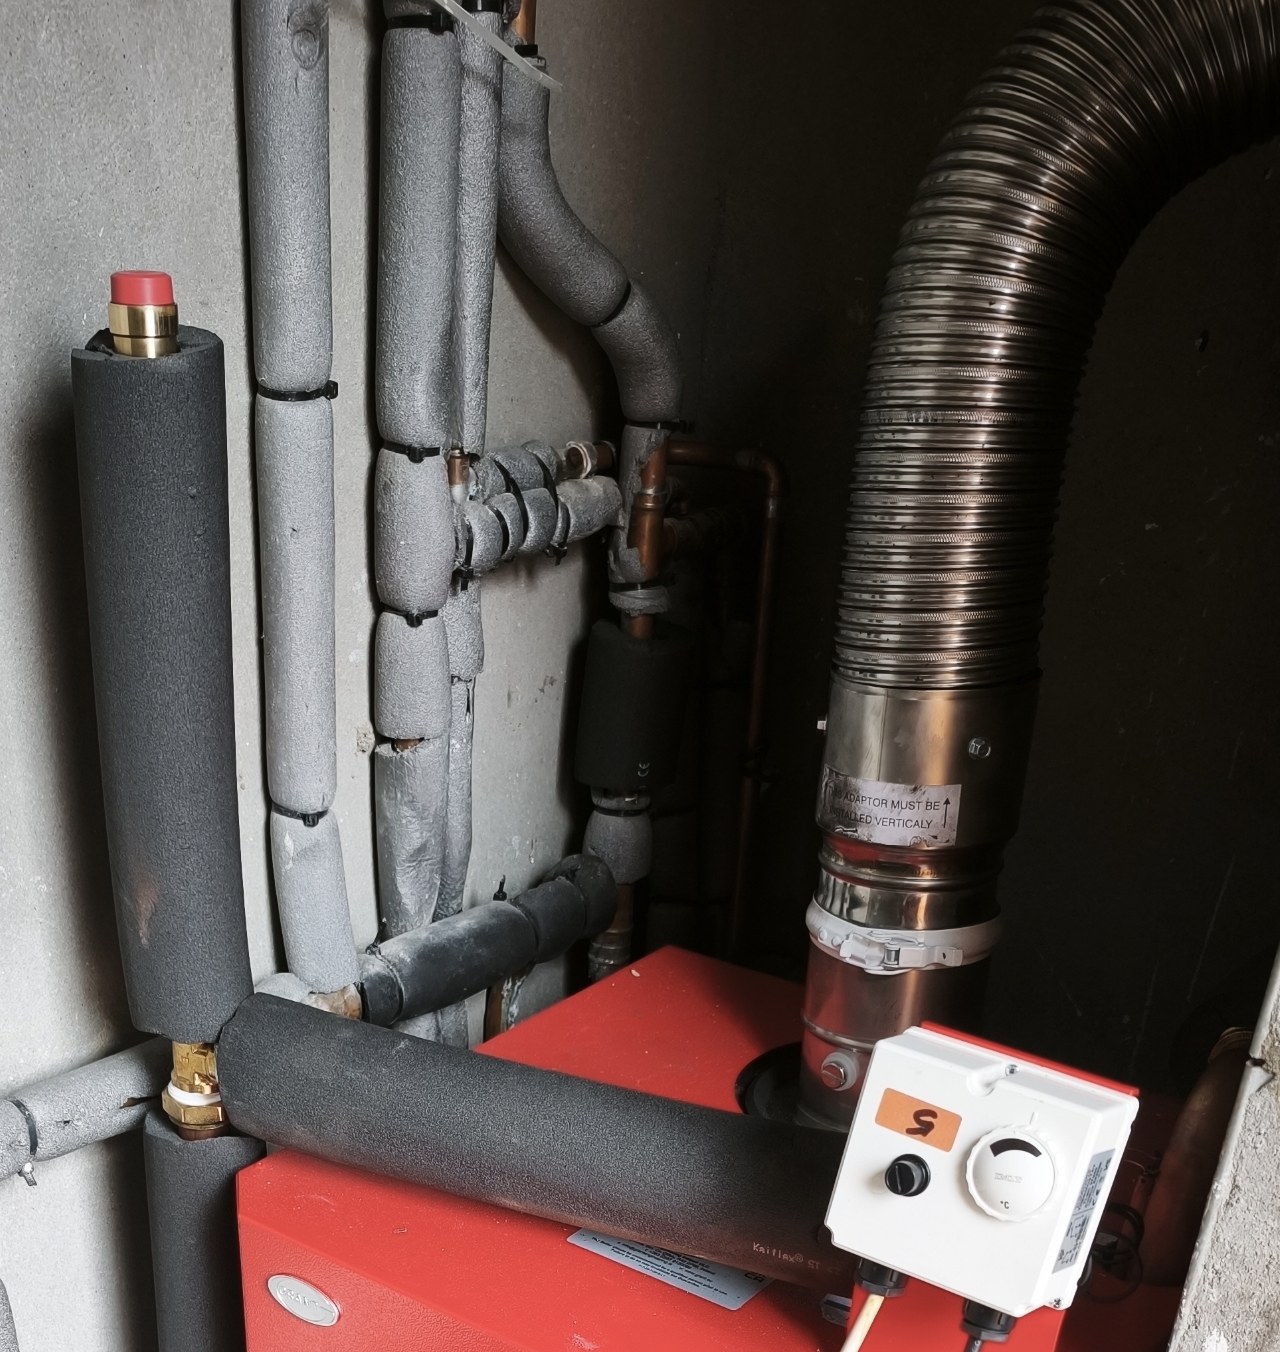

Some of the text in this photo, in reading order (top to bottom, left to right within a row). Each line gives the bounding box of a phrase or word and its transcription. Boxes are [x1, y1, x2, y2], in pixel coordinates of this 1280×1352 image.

[890, 799, 922, 811] MUST
[925, 800, 941, 811] BE
[874, 816, 933, 830] VERTICALY
